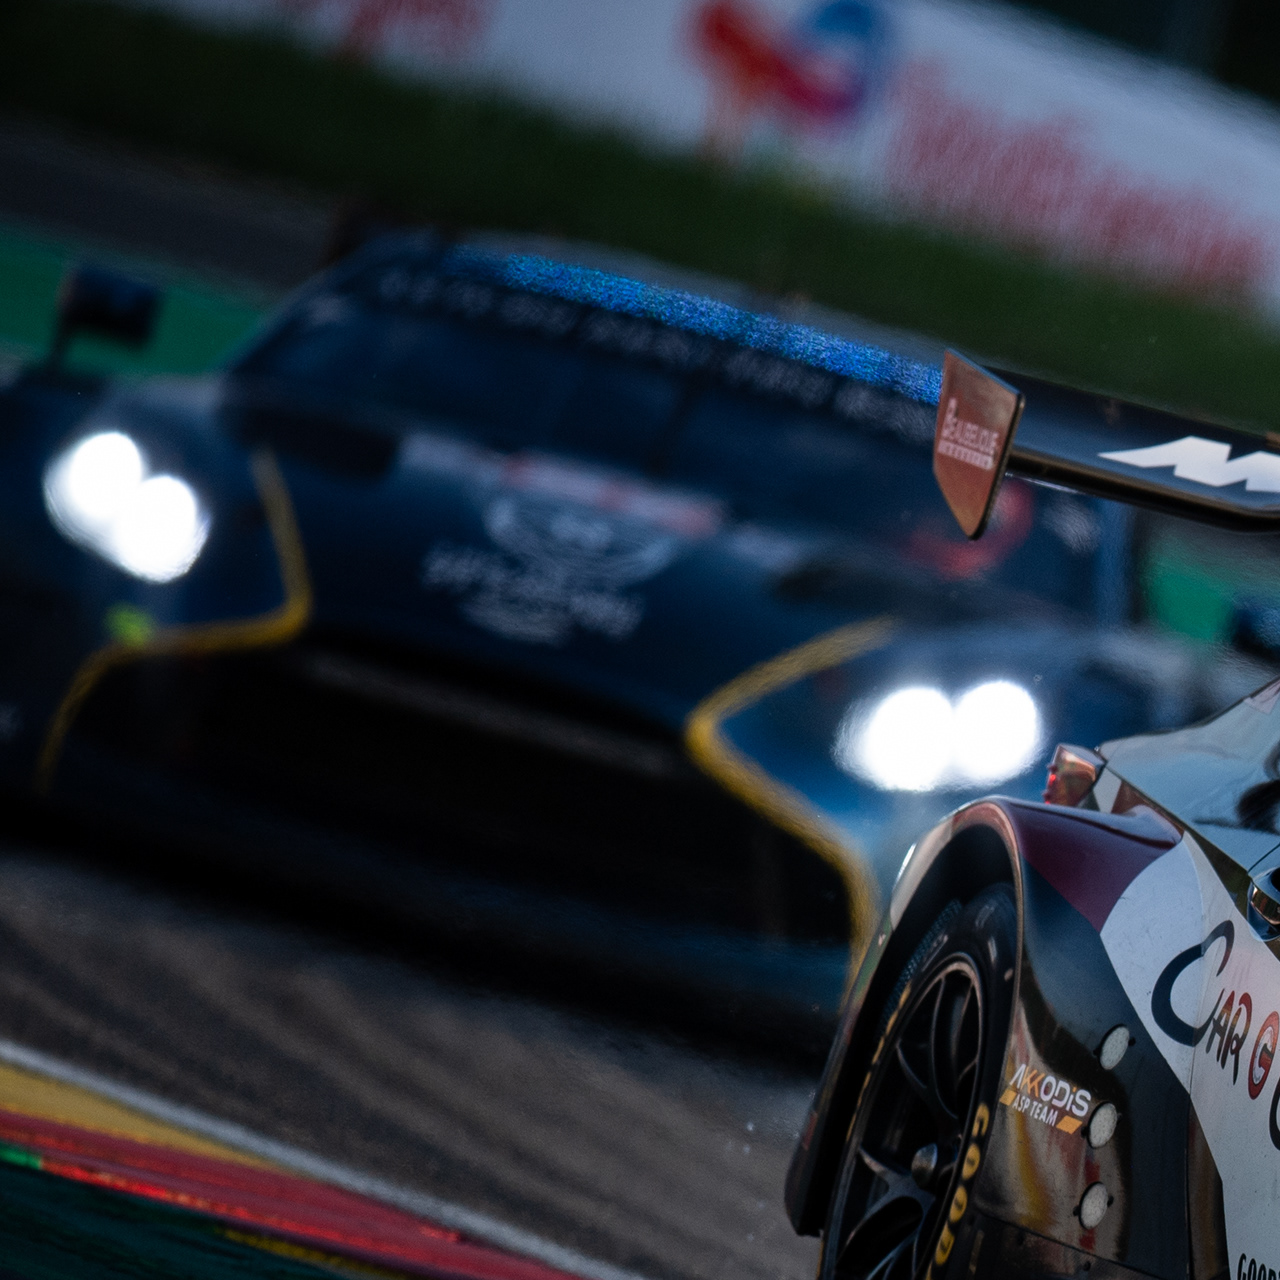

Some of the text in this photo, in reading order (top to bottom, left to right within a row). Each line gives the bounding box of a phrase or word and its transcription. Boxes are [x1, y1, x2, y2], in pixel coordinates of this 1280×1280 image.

[1008, 1063, 1092, 1117] AKKODIS
[1012, 1093, 1059, 1127] ASP TEAM
